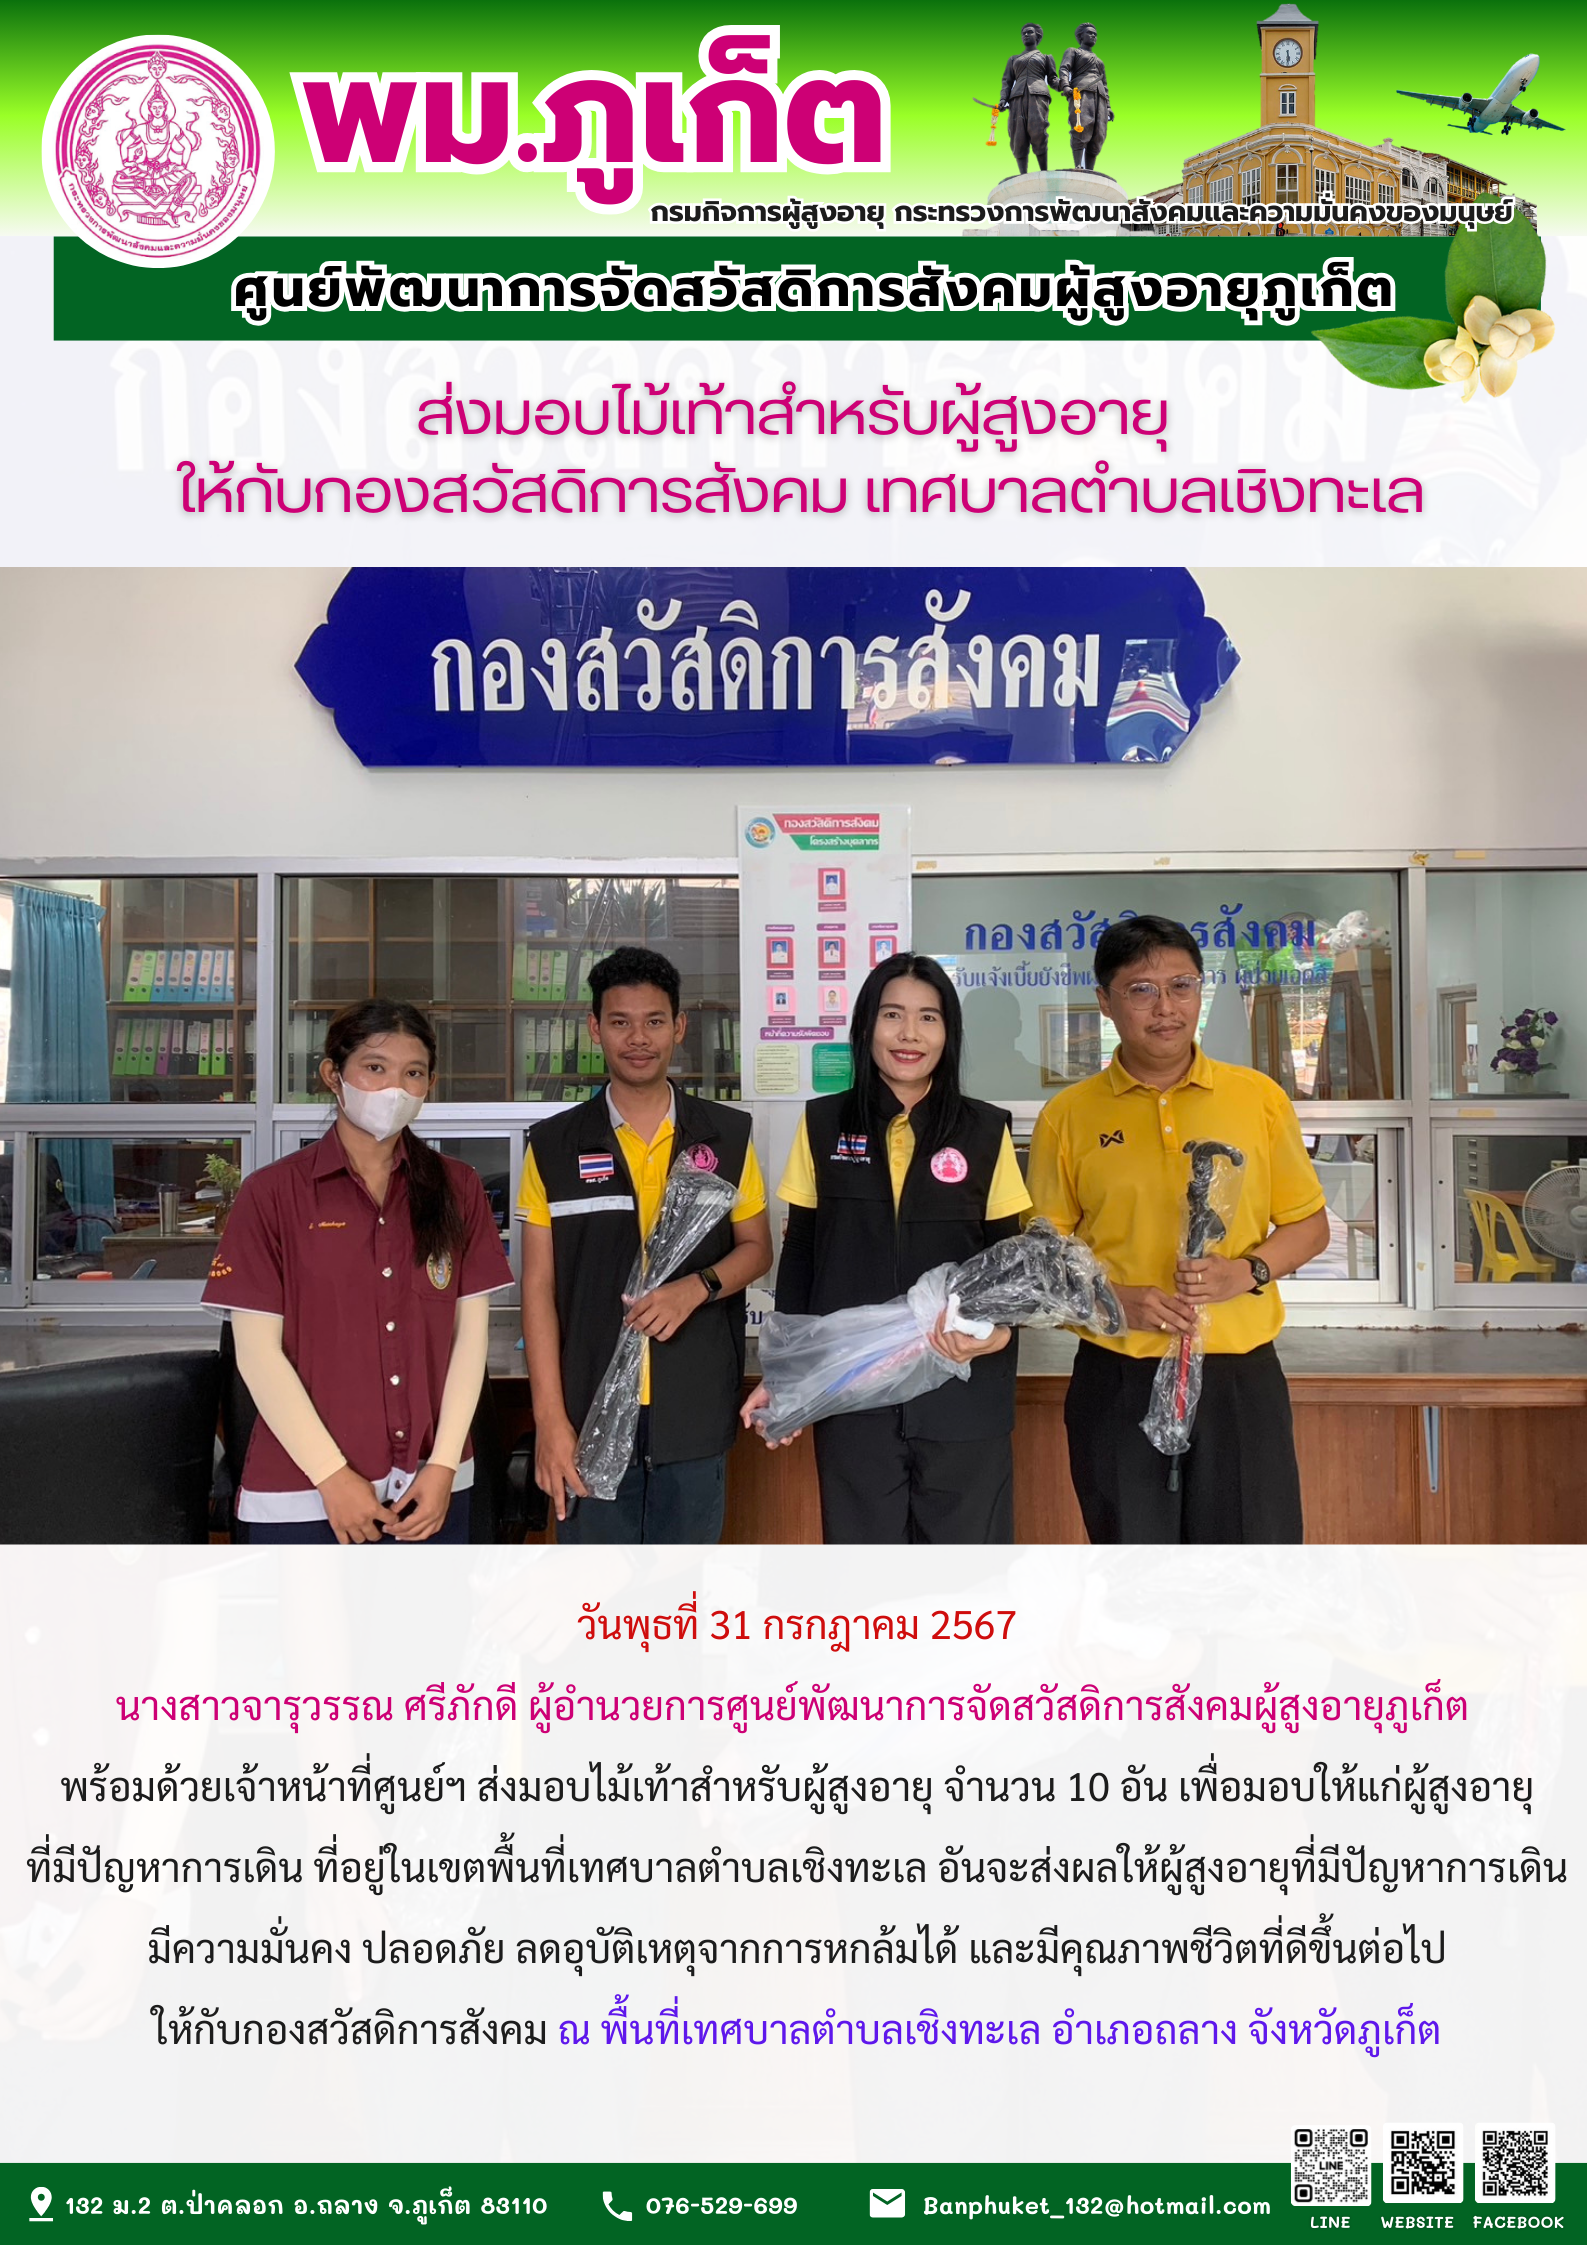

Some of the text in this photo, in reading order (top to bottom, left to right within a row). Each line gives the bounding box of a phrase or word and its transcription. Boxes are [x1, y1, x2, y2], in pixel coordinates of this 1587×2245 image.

[431, 588, 1100, 712] กองสวัสดิการสังคม
